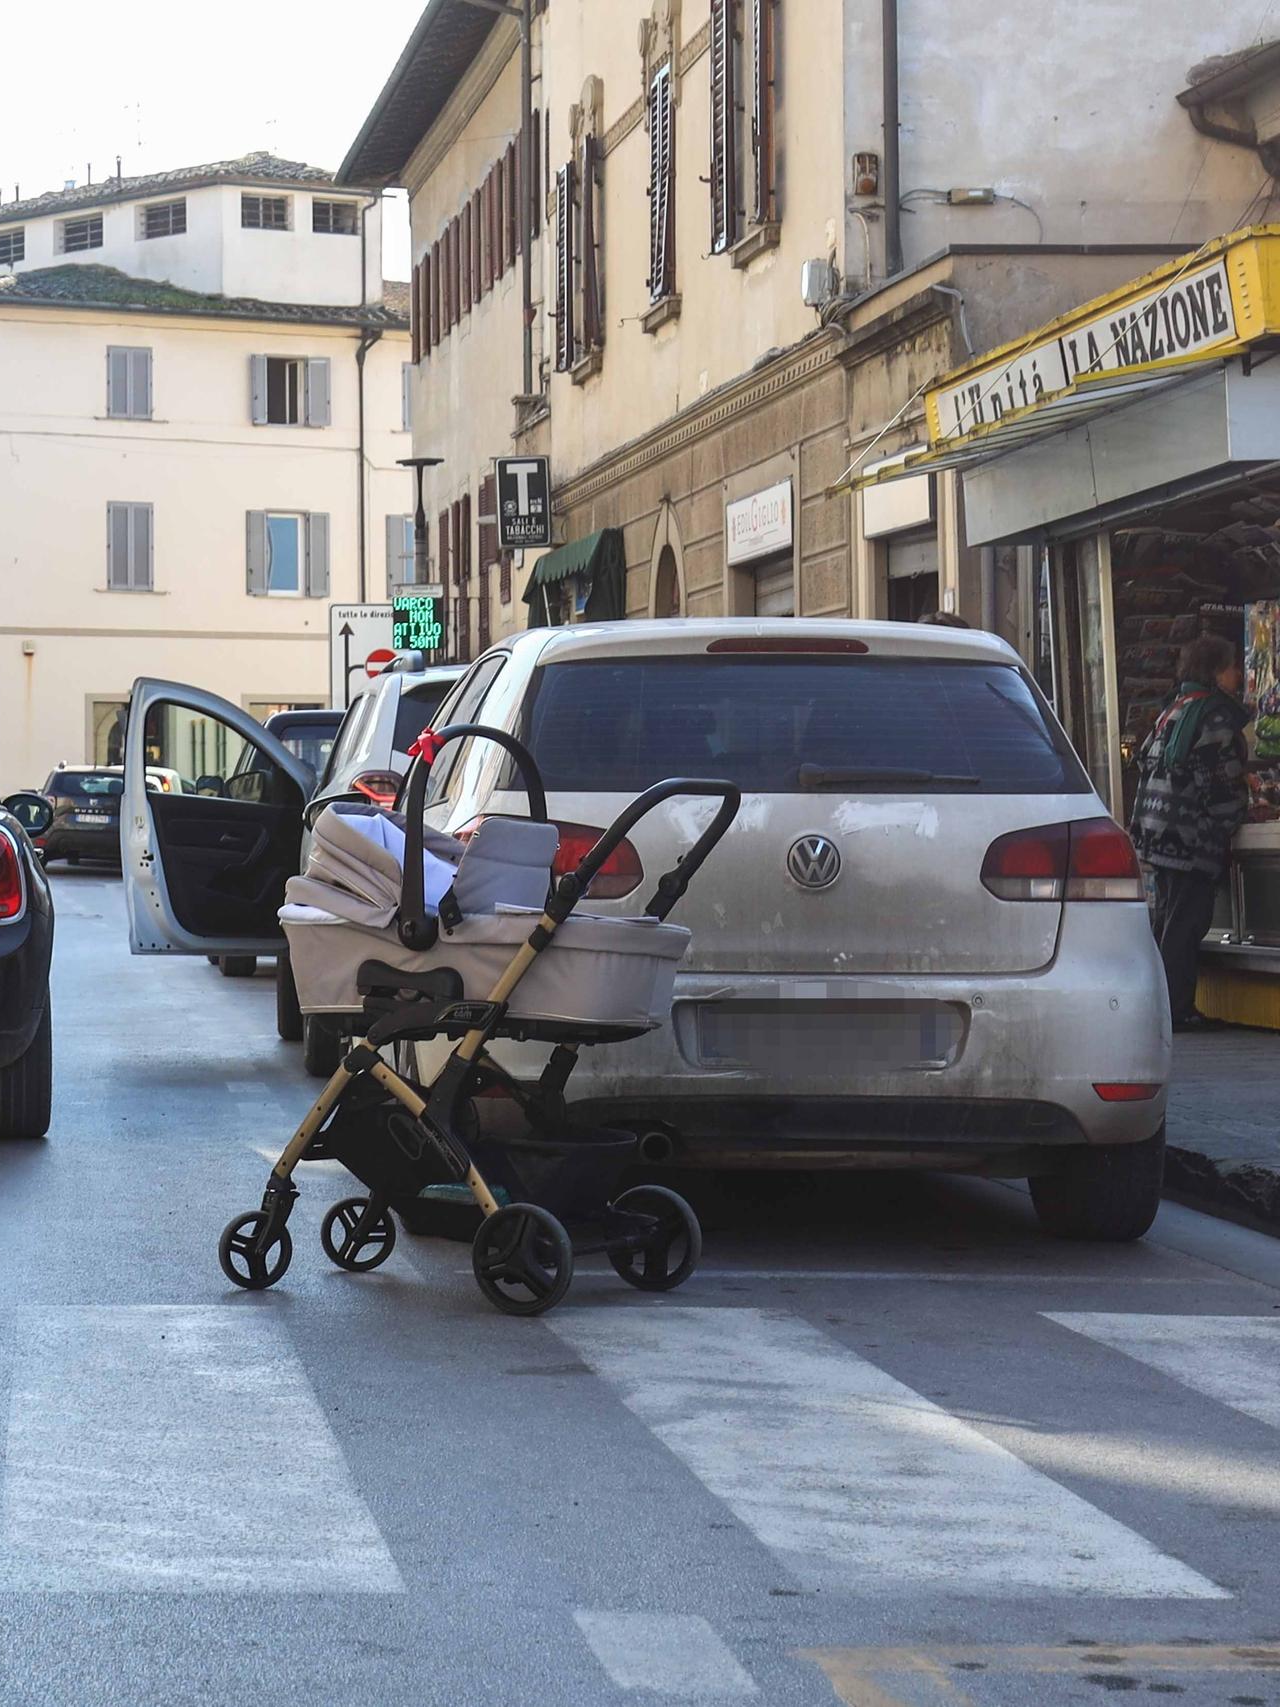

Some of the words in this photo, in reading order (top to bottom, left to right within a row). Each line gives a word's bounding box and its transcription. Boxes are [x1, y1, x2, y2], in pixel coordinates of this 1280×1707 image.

[1070, 331, 1104, 374] LA
[1110, 271, 1229, 367] NAZIONE
[506, 462, 538, 516] T
[511, 517, 529, 526] SALI
[505, 524, 545, 536] TABACCHI
[393, 597, 434, 610] VARCO
[338, 610, 359, 619] tutte
[359, 610, 368, 618] le
[409, 609, 434, 623] NON
[393, 622, 442, 636] ATTIVO
[393, 635, 403, 649] A
[409, 635, 440, 649] 50MT
